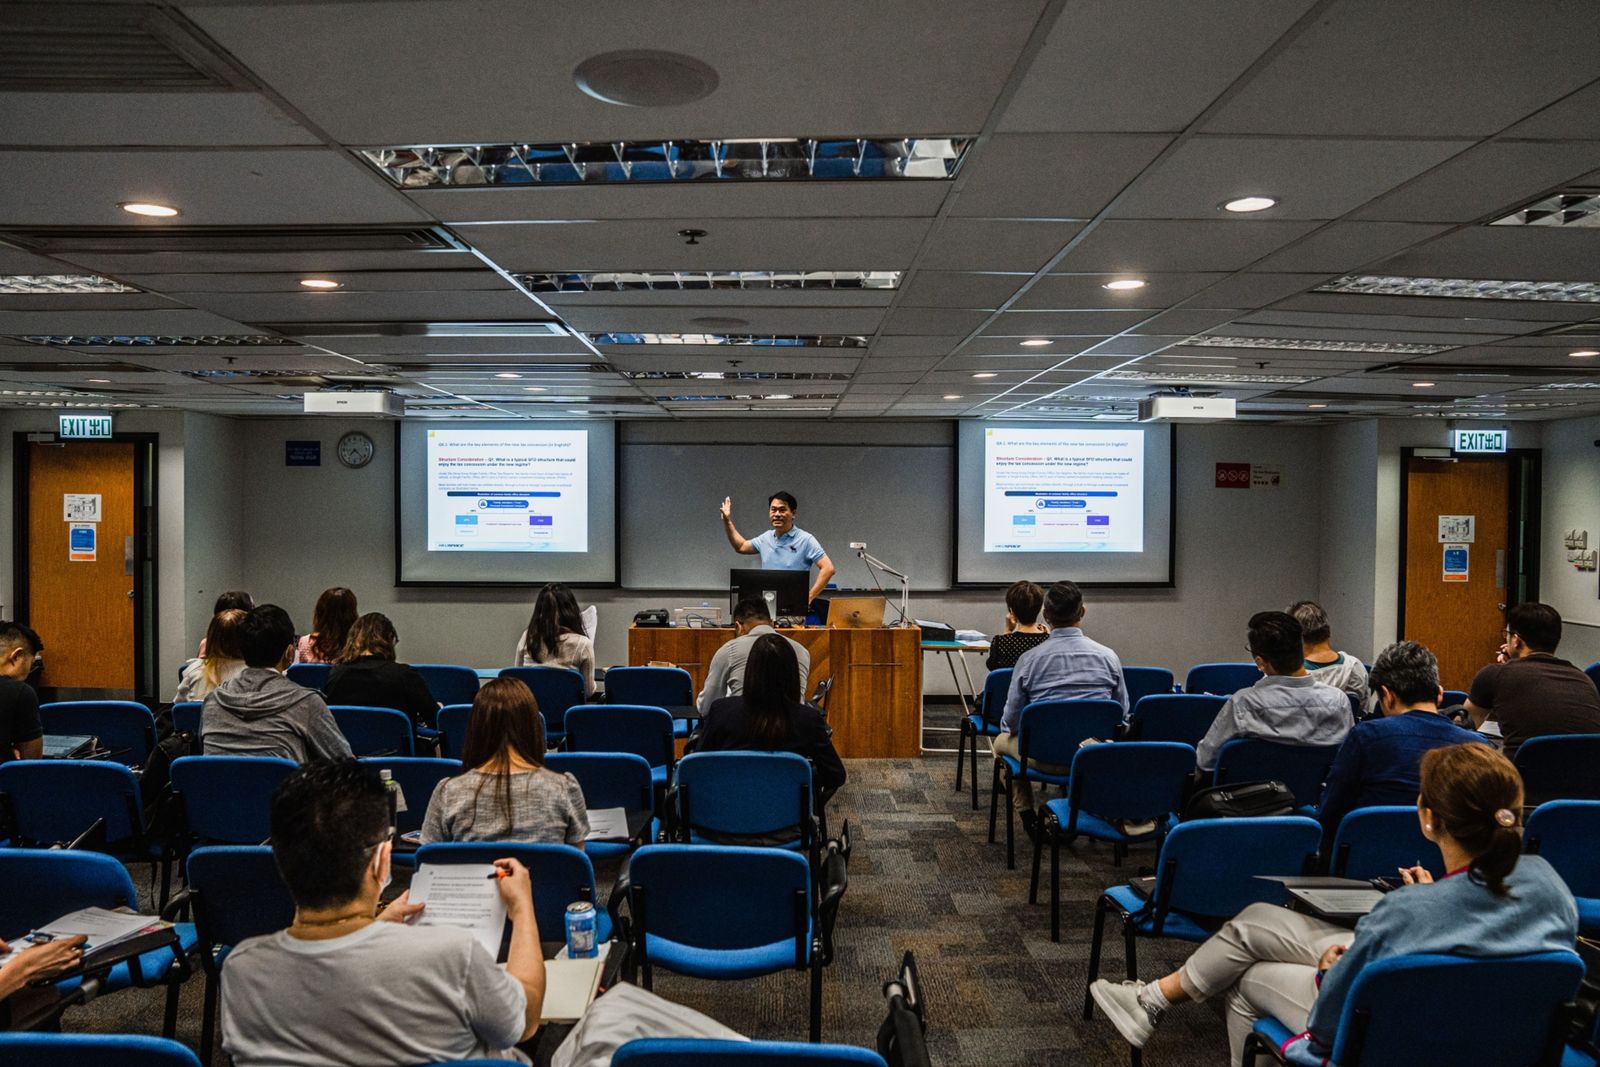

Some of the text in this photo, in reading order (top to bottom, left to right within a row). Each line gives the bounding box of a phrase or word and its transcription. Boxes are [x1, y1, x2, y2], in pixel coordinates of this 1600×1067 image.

[61, 418, 110, 436] EXIT 出口
[1460, 433, 1502, 450] EXIT 出口
